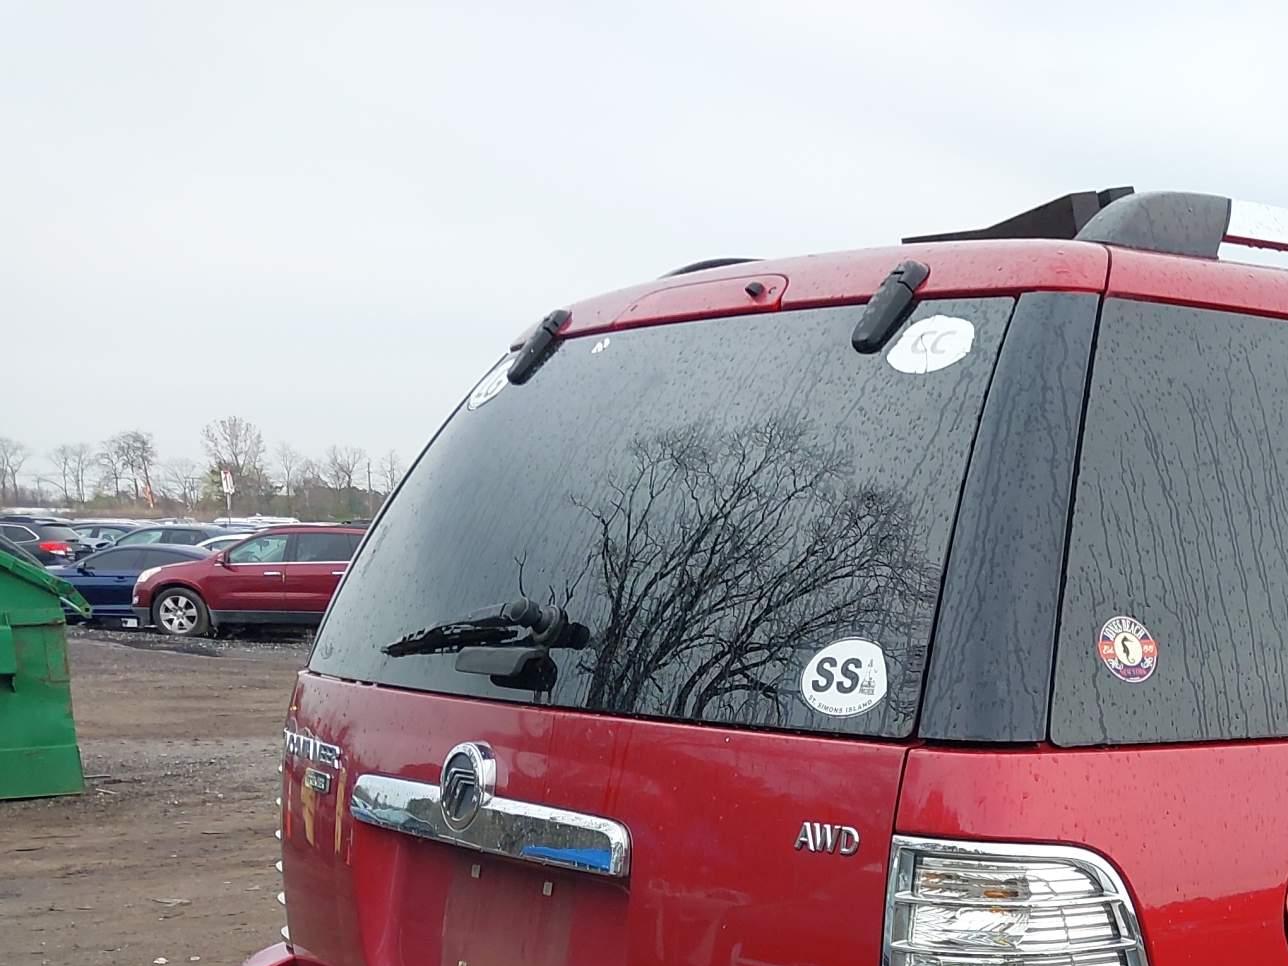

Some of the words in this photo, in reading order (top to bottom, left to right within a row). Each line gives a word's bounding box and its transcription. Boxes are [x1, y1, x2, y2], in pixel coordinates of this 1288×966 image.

[1121, 619, 1146, 640] BEACH
[811, 656, 863, 694] SS
[817, 702, 843, 713] SIMONS
[845, 699, 873, 713] ISLAND
[794, 821, 860, 855] AWD
